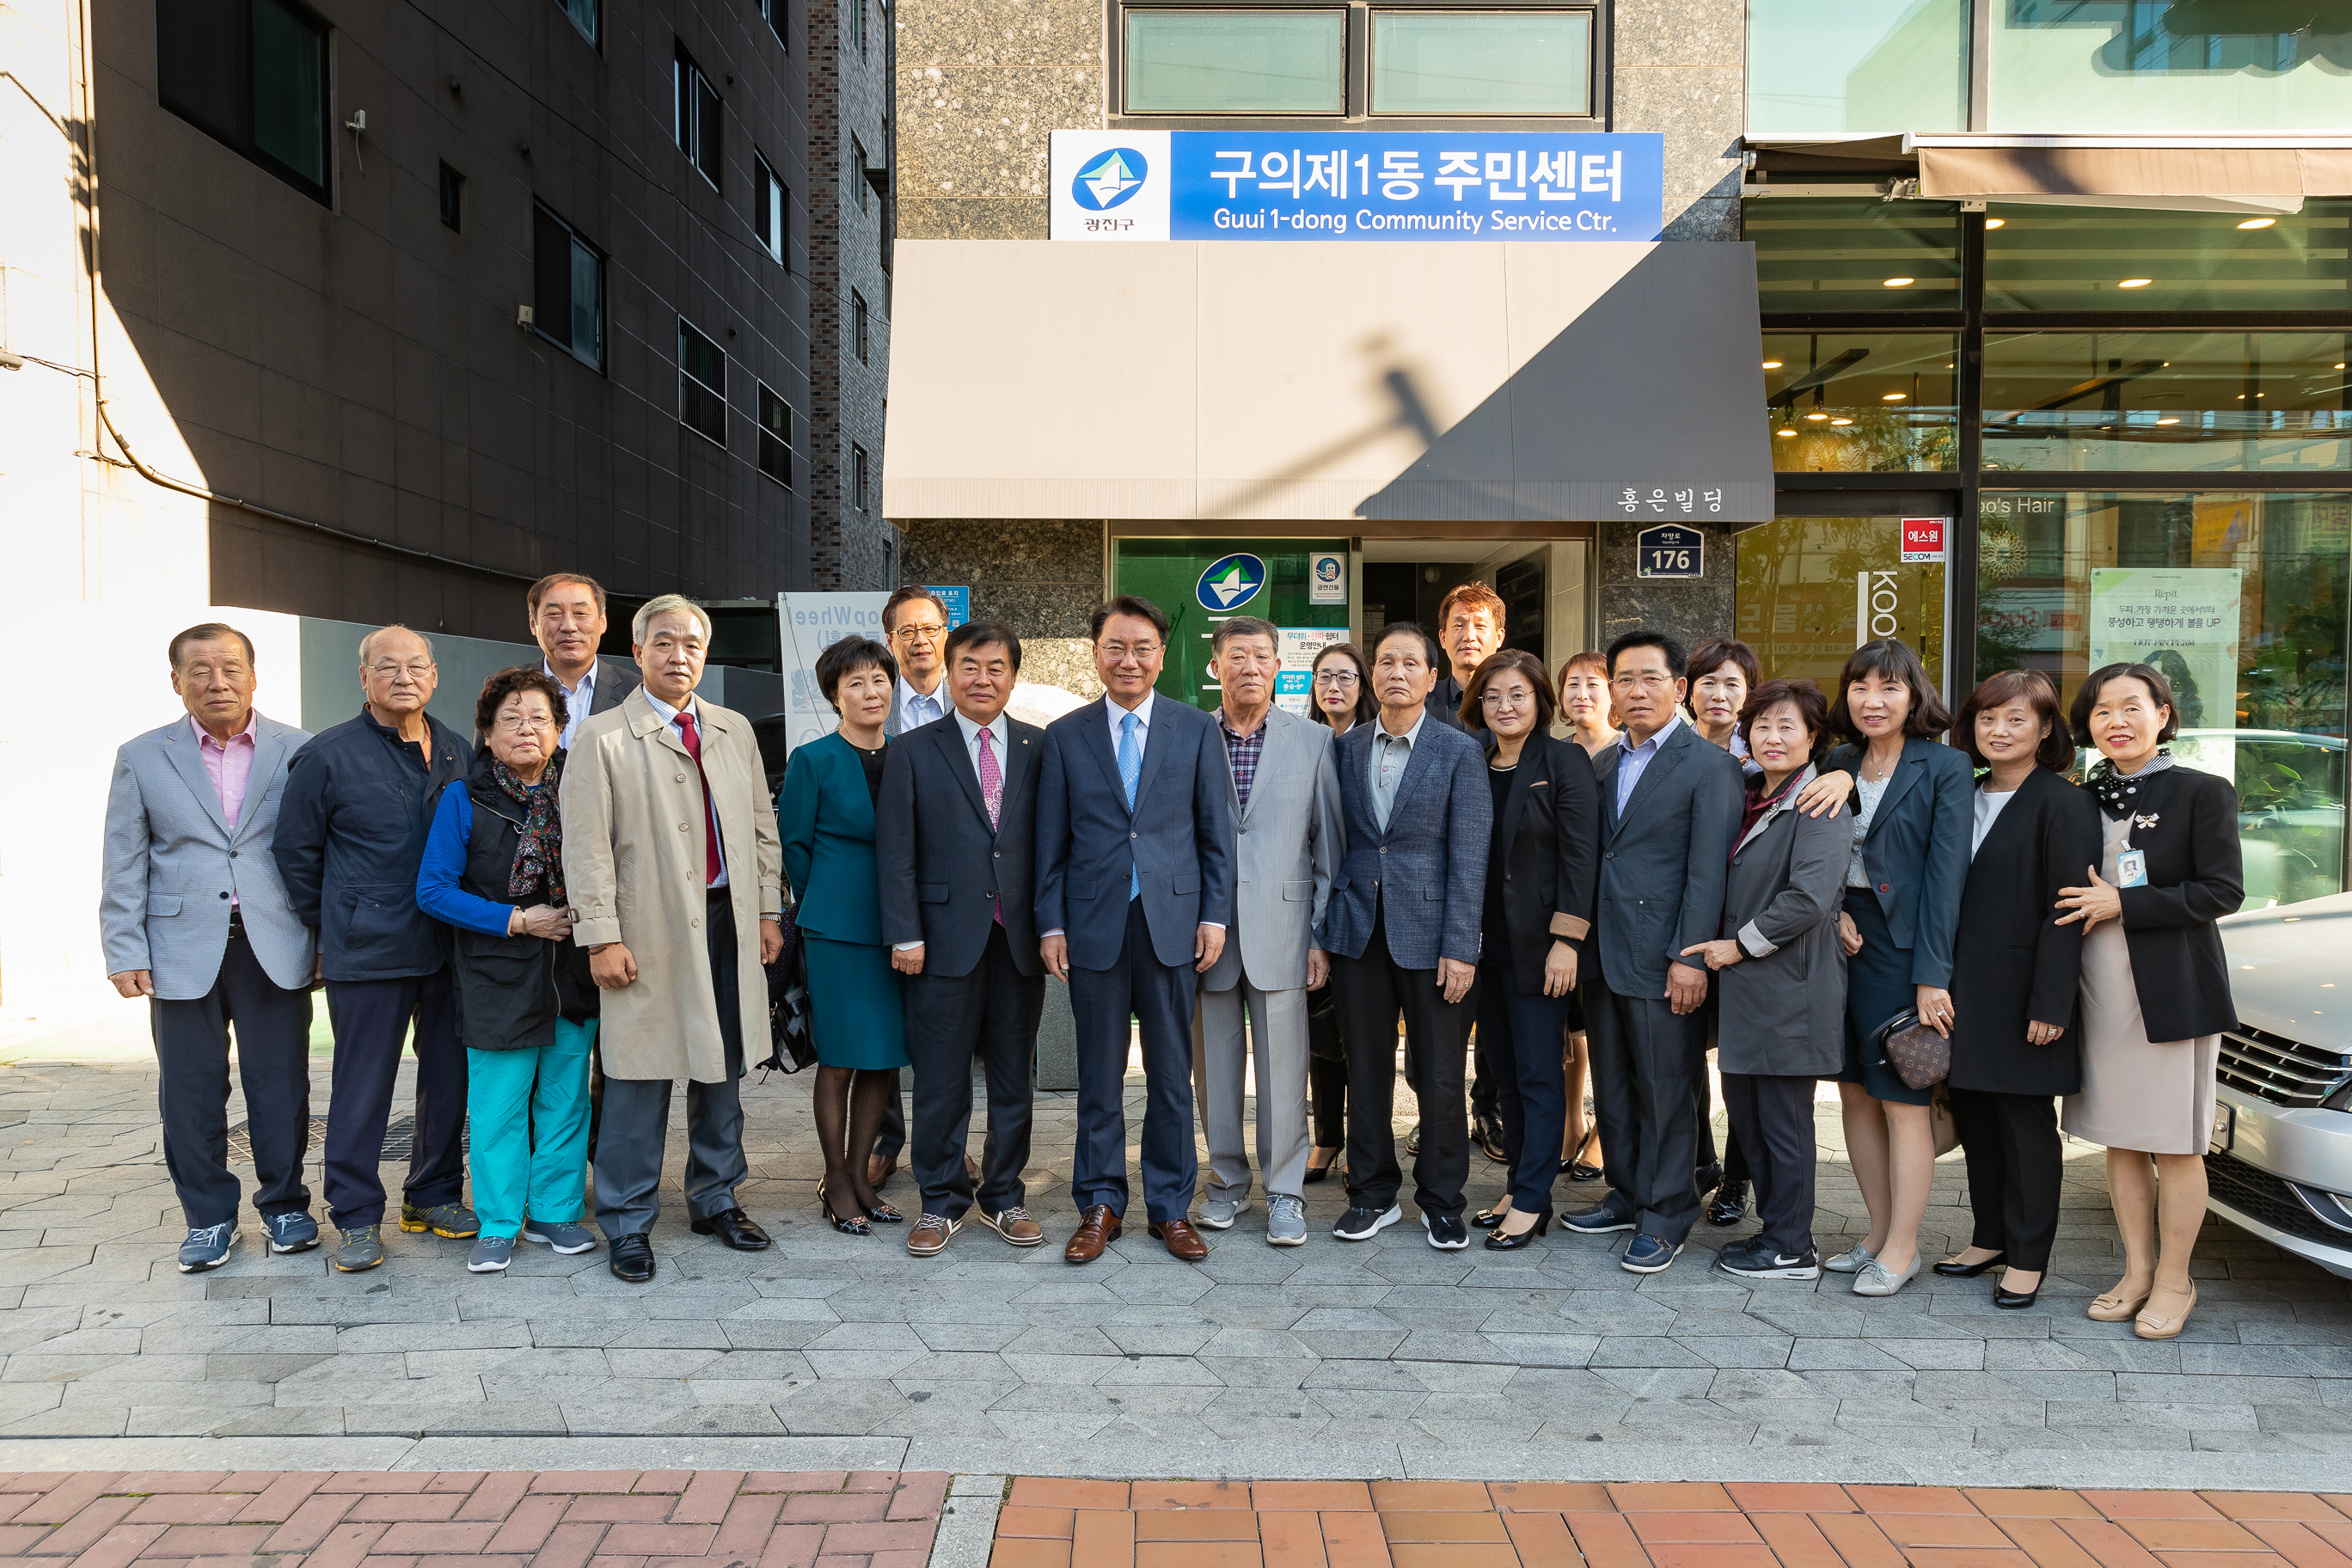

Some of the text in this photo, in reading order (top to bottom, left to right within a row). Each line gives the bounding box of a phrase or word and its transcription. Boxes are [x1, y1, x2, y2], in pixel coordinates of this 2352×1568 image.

[1210, 149, 1622, 202] 구의제1동 주민센터
[1083, 218, 1135, 232] 광진구
[1214, 207, 1617, 235] Guui 1-dong Community Service Ctr.
[1617, 487, 1722, 513] 홍은빌딩
[2018, 498, 2055, 513] Hair
[1661, 532, 1681, 541] 자양로
[1908, 530, 1939, 542] 에스원
[1651, 549, 1690, 570] 176
[2118, 605, 2215, 615] 두피 가장 가까운 곳에서부터
[2108, 617, 2144, 628] 풍성하고
[2187, 617, 2204, 628] 볼륨
[2206, 618, 2221, 628] UP
[1286, 632, 1339, 640] 무더위 한파 쉼터
[1299, 641, 1326, 650] 운영안내
